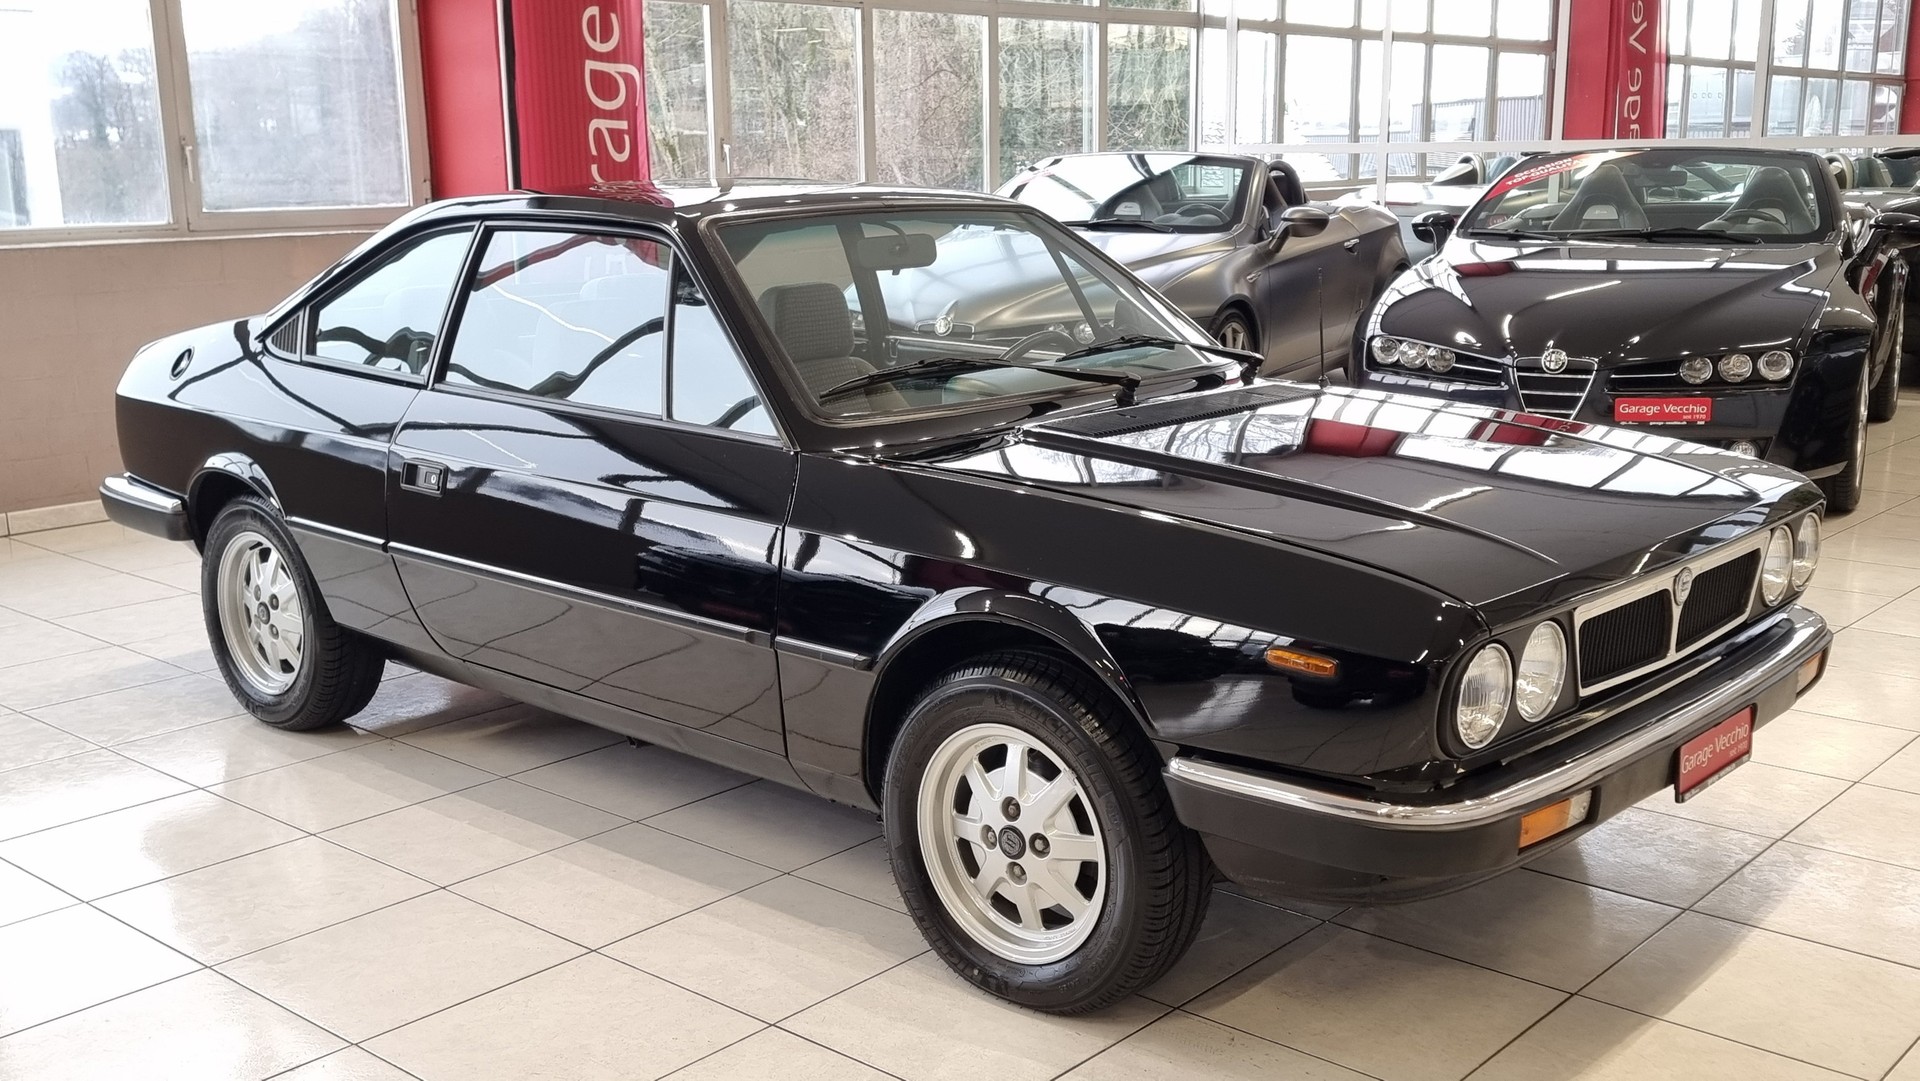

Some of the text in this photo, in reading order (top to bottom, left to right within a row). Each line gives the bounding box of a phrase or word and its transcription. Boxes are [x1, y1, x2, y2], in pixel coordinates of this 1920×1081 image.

[1514, 157, 1573, 178] OCCASION
[1619, 403, 1708, 416] Garage Vecchio
[1682, 723, 1748, 774] Garage Vecchio
